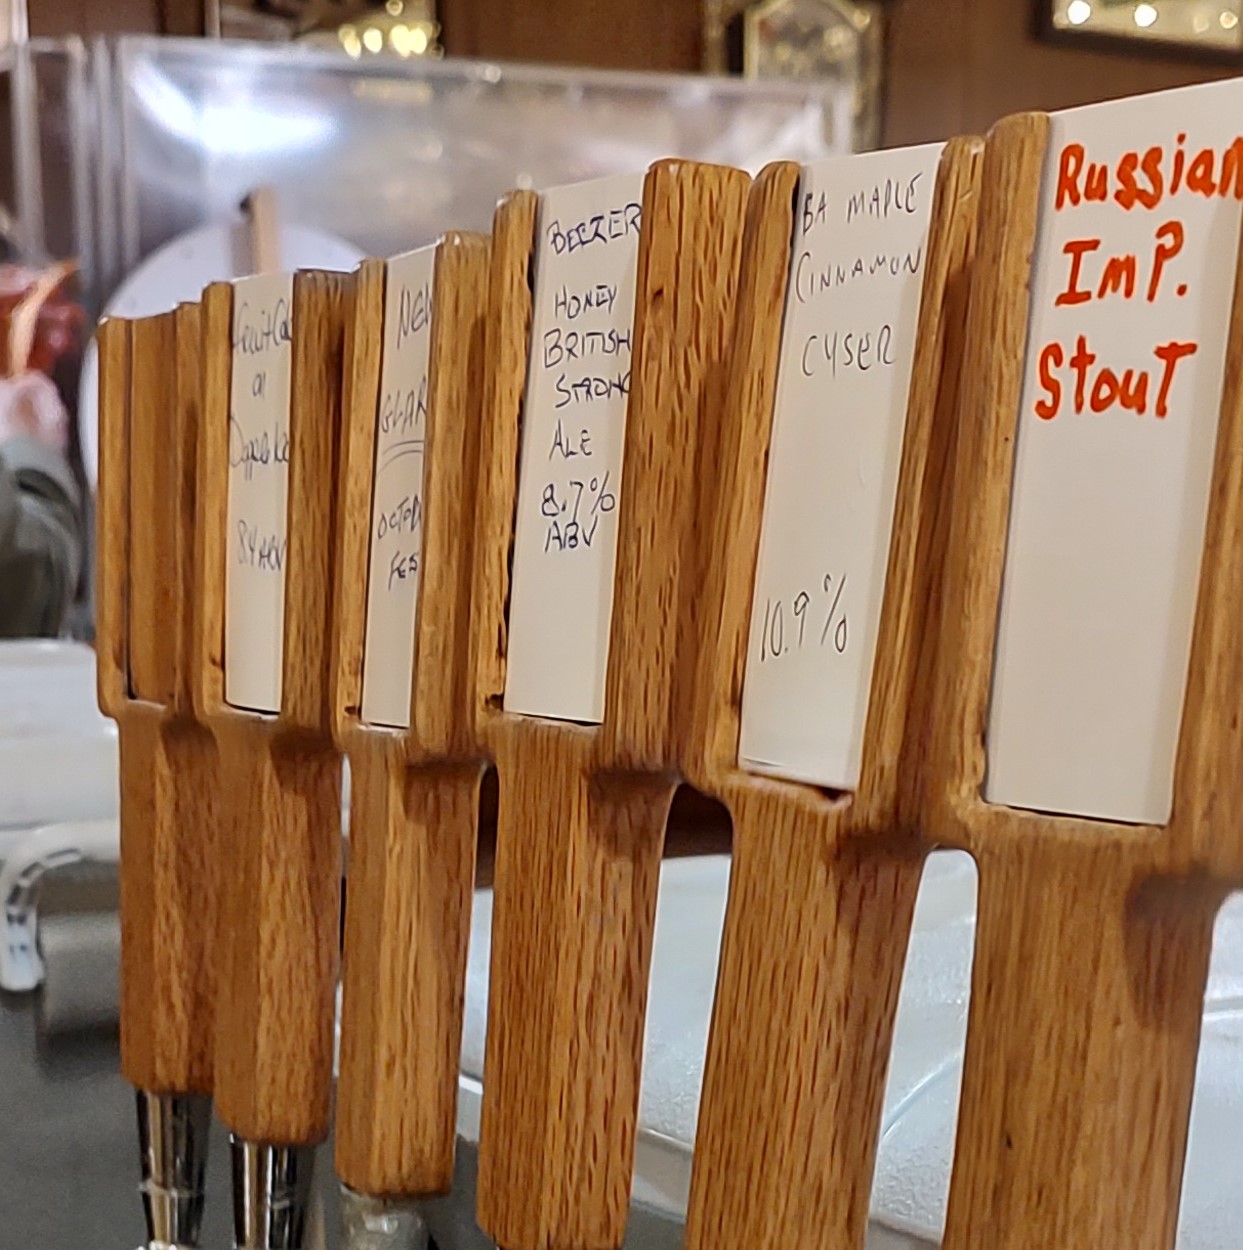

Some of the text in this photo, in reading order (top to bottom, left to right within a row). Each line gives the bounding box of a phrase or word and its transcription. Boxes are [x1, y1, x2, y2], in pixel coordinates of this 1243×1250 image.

[846, 172, 922, 224] MAPLE
[795, 247, 922, 303] CINNAMON
[554, 284, 617, 319] HONEY
[544, 328, 631, 368] BRITISH
[541, 471, 616, 522] 8.7%
[545, 515, 608, 552] ABV
[760, 572, 847, 662] 10.9%
